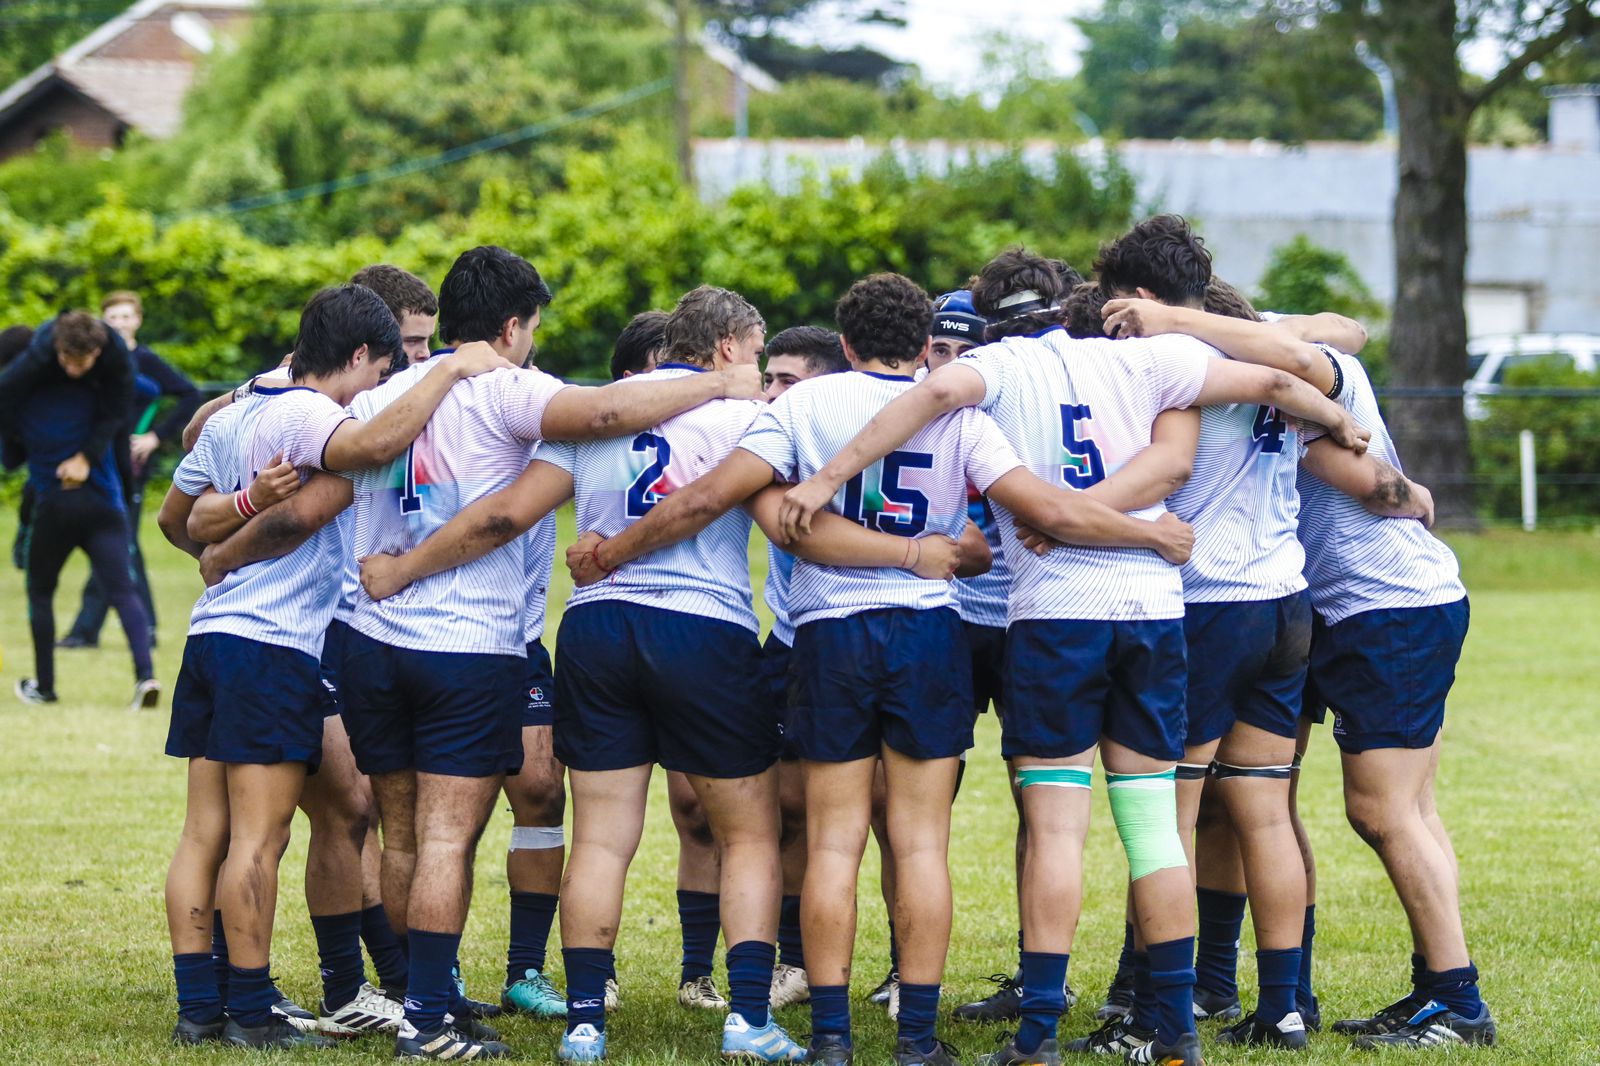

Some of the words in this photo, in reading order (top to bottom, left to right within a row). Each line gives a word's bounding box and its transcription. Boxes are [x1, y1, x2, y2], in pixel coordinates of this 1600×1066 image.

[940, 320, 969, 332] TWS
[1059, 402, 1106, 490] 5
[1251, 403, 1288, 455] 4
[400, 440, 423, 515] 1
[625, 432, 672, 519] 2
[843, 449, 934, 539] 15
